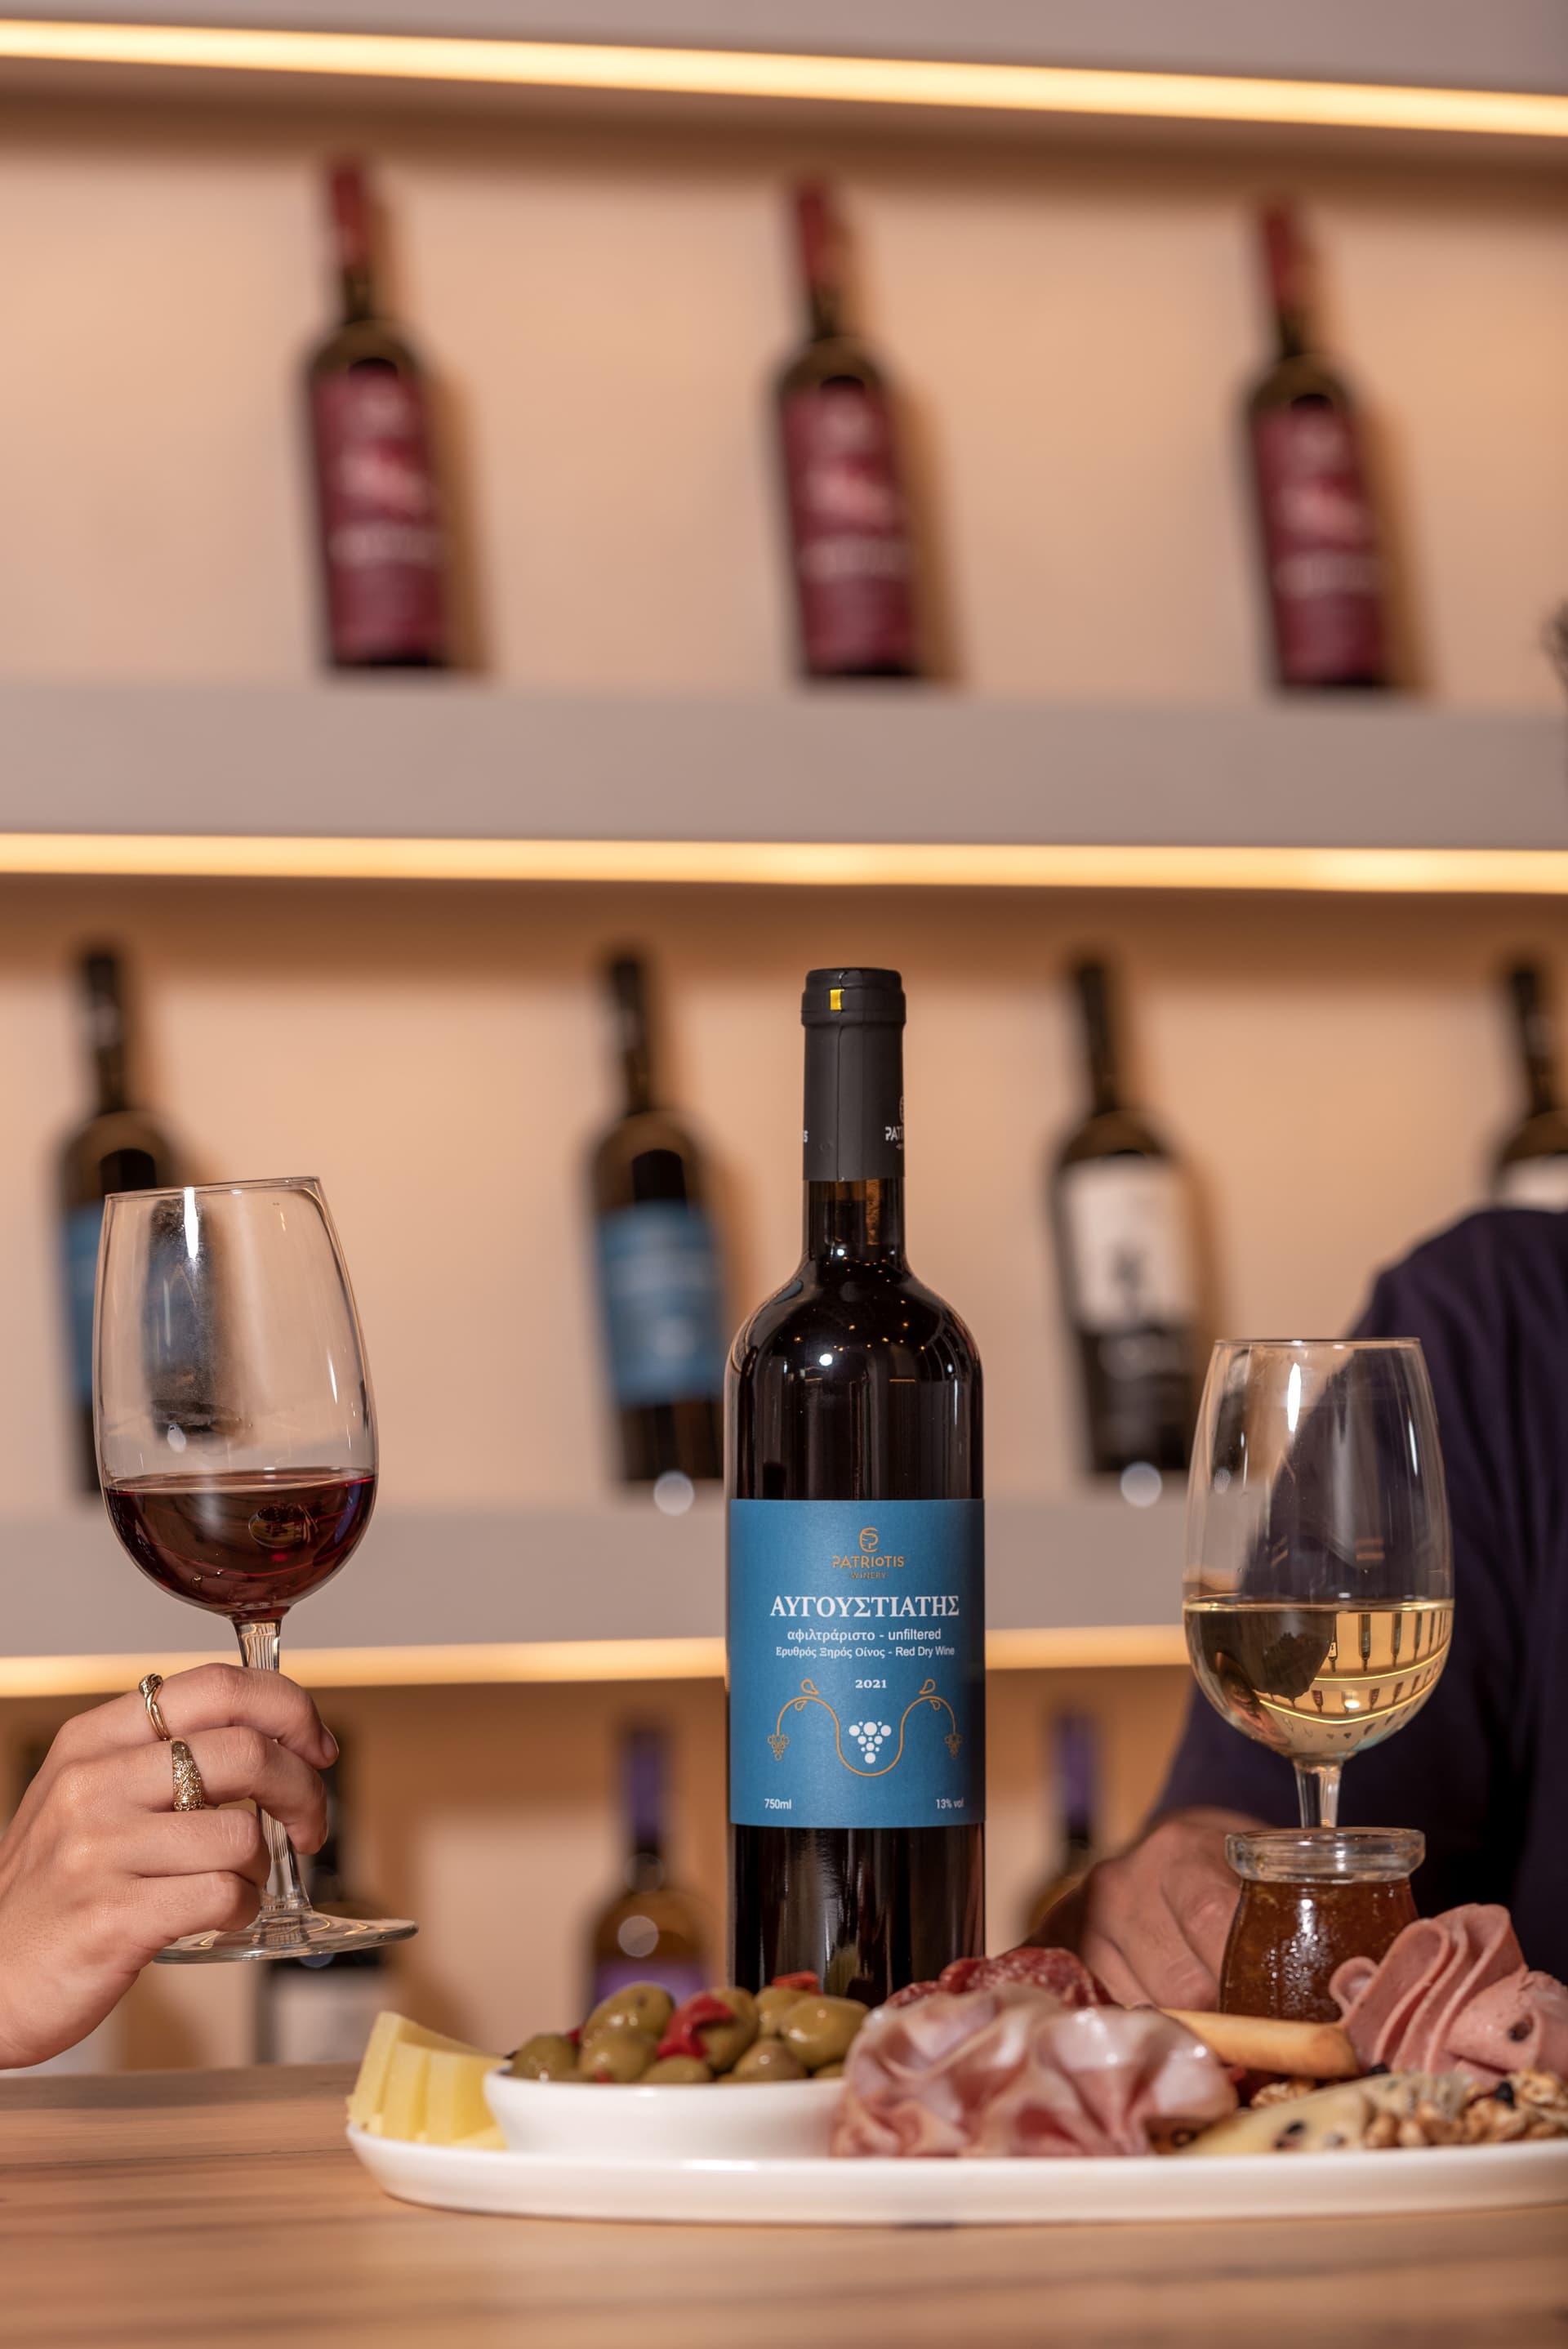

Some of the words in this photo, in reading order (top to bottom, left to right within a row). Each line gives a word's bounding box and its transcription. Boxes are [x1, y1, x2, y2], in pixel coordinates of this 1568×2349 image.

[831, 1554, 905, 1569] PATRIOTIS
[769, 1595, 960, 1618] ΑΥΓΟΥΣΤΙΑΤΗΣ
[786, 1628, 875, 1644] αφιλτράριστο
[888, 1628, 942, 1641] unfiltered
[775, 1646, 817, 1660] Ερυθρός
[819, 1646, 853, 1660] Ξηρός
[855, 1646, 885, 1660] Οίνος
[895, 1646, 915, 1657] Red
[917, 1646, 933, 1659] Dry
[934, 1646, 955, 1656] Wine
[855, 1678, 887, 1689] 2021
[764, 1798, 792, 1810] 750ml
[935, 1798, 952, 1809] 13%
[953, 1797, 964, 1809] vol
